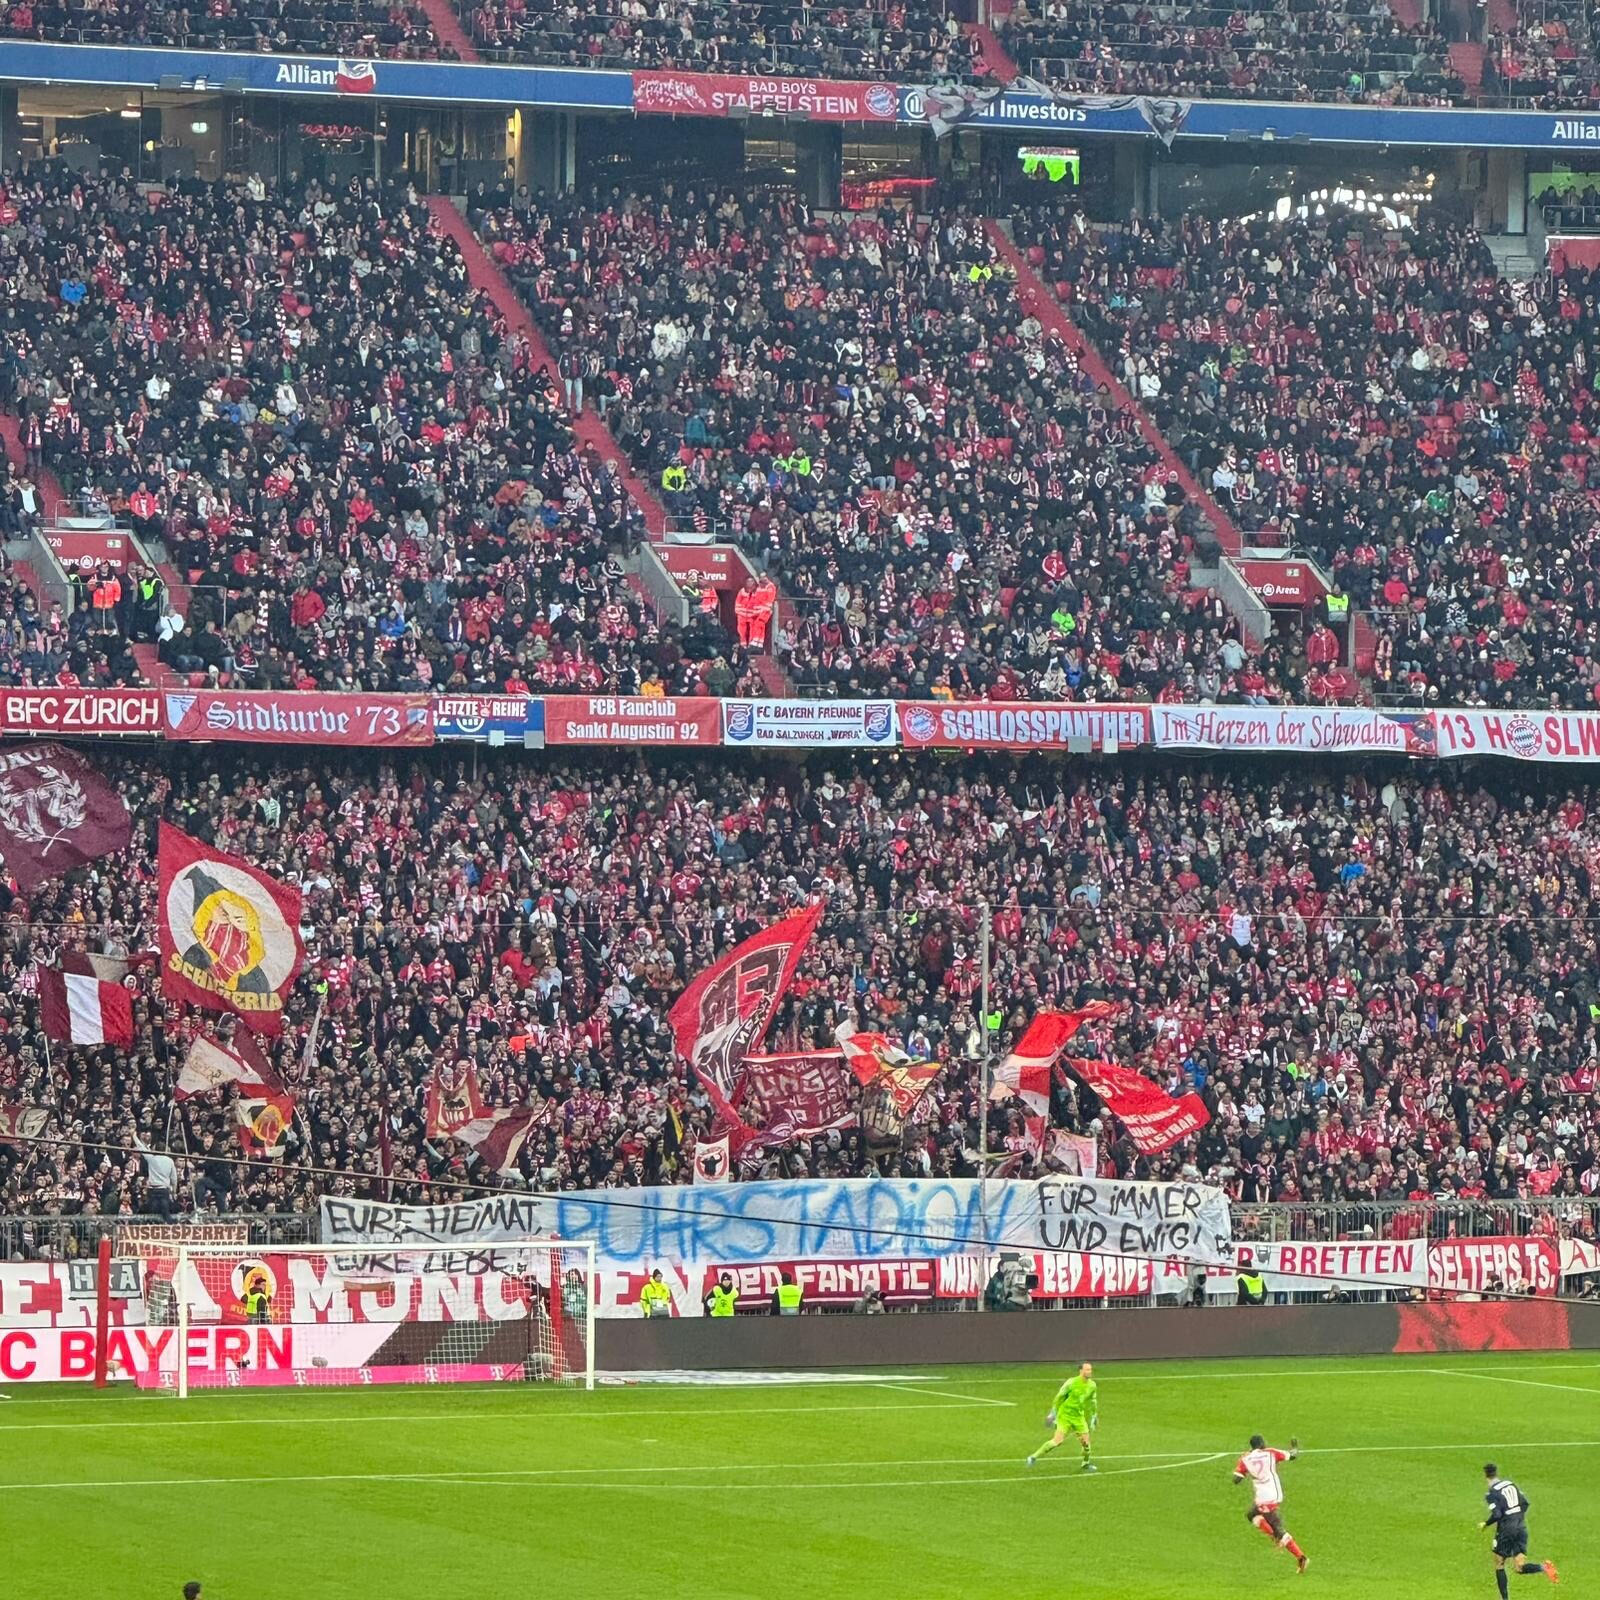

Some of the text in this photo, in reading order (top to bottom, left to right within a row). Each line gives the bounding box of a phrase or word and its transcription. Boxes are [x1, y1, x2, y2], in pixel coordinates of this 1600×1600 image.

[276, 63, 338, 85] Allian
[749, 81, 817, 95] BAD BOYS
[1000, 101, 1087, 121] Investors
[6, 694, 159, 725] BFC ZÜRICH
[206, 700, 350, 734] Südkurve
[438, 699, 527, 717] LETZTE REIHE
[589, 699, 677, 717] FCB Fanclub
[756, 706, 771, 718] FC
[774, 706, 814, 719] BAYERN
[566, 721, 608, 739] Sankt
[610, 722, 675, 740] Augustin
[941, 709, 1145, 744] SCHLOSSPANTHER
[1161, 710, 1399, 748] Im Herzen der Schwalm
[1440, 713, 1476, 749] 13
[1038, 1182, 1098, 1216] FÜR
[119, 1225, 247, 1241] AUSGESPERRTE
[326, 1200, 415, 1236] EURE
[1039, 1219, 1107, 1250] UND
[1089, 1254, 1151, 1294] PRIDE
[1279, 1244, 1414, 1275] BRETTEN
[1429, 1243, 1523, 1293] SELTERS
[60, 1326, 293, 1379] BAYERN
